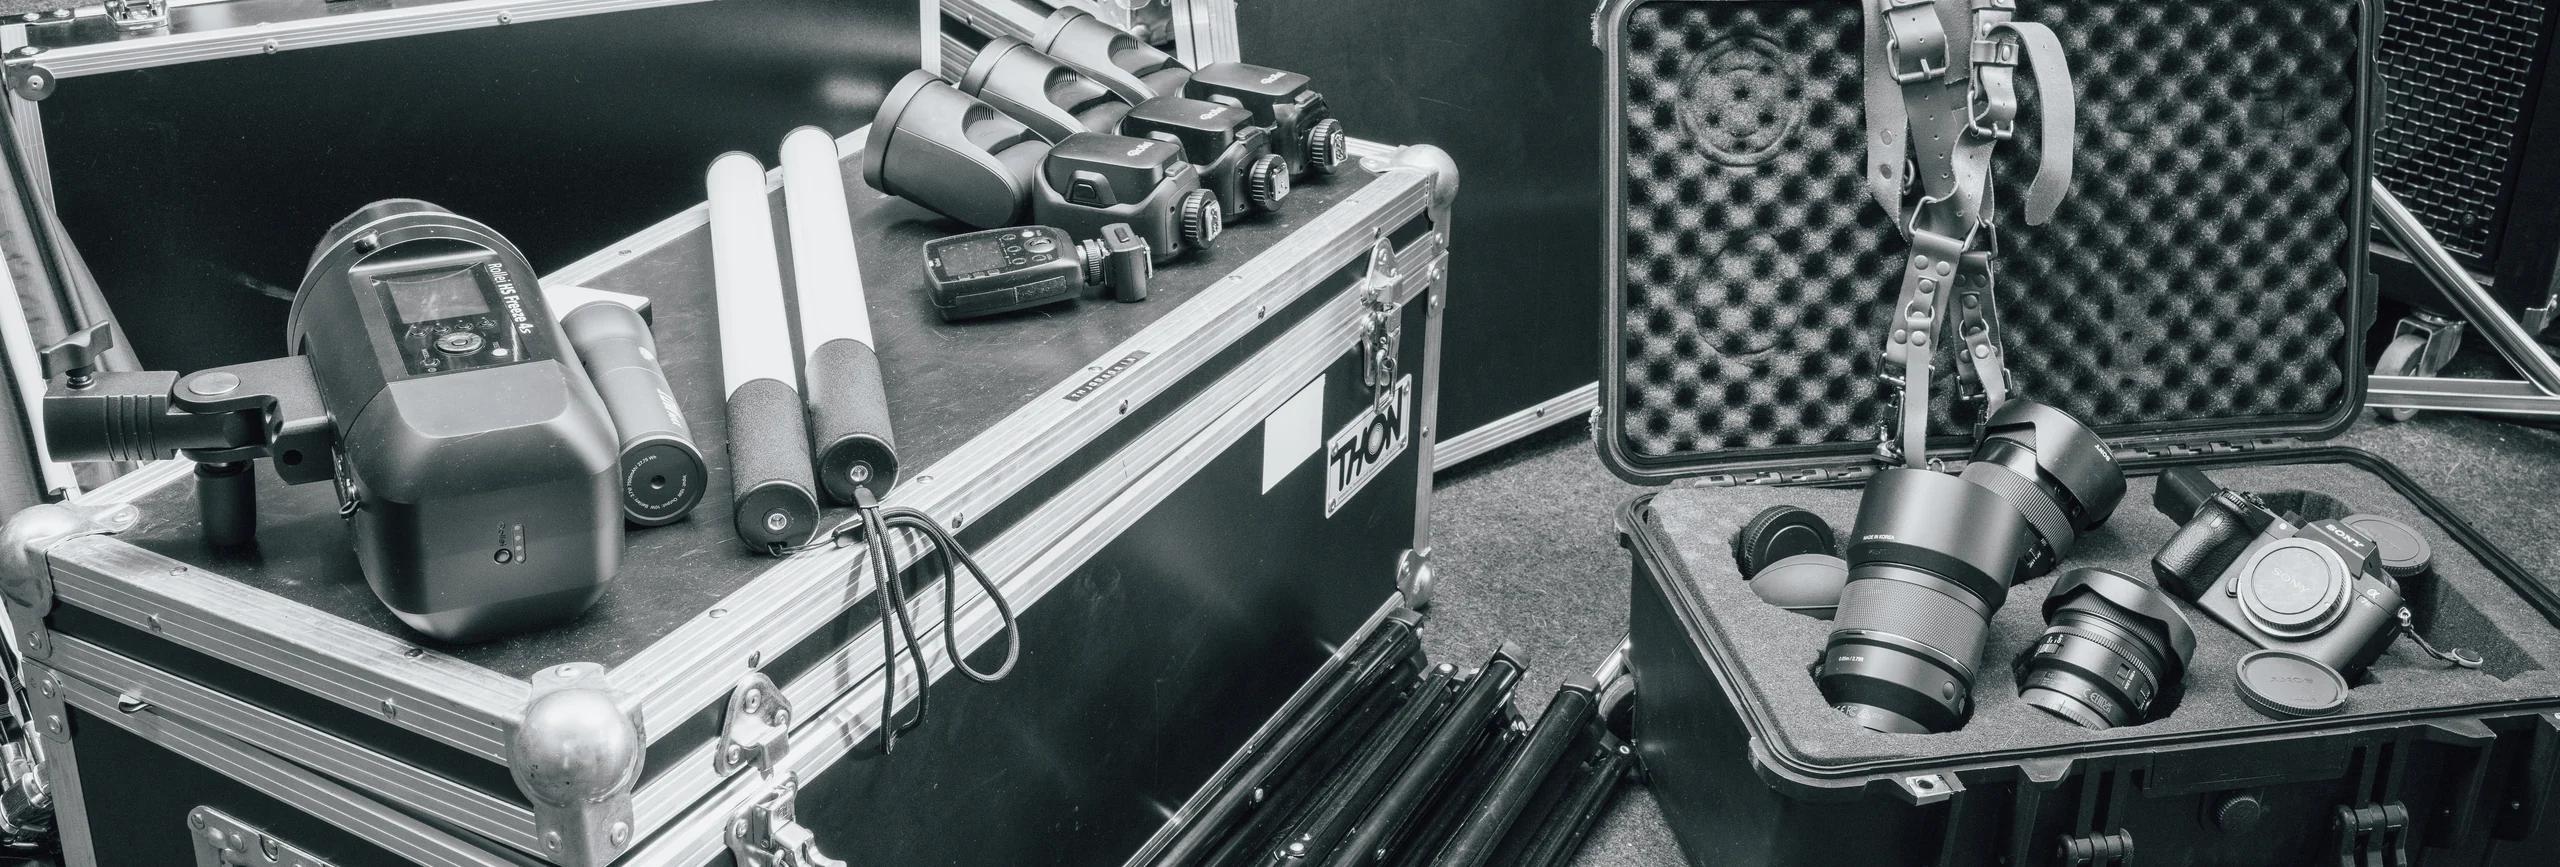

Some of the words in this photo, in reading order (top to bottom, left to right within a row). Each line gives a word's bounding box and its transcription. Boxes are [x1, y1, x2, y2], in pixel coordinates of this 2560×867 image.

[488, 263, 511, 283] Rollei
[498, 283, 517, 295] HS
[503, 295, 527, 322] Freeze
[518, 323, 534, 334] 4s
[1331, 385, 1403, 492] THON
[2325, 523, 2365, 548] SONY
[2271, 566, 2312, 593] SONY
